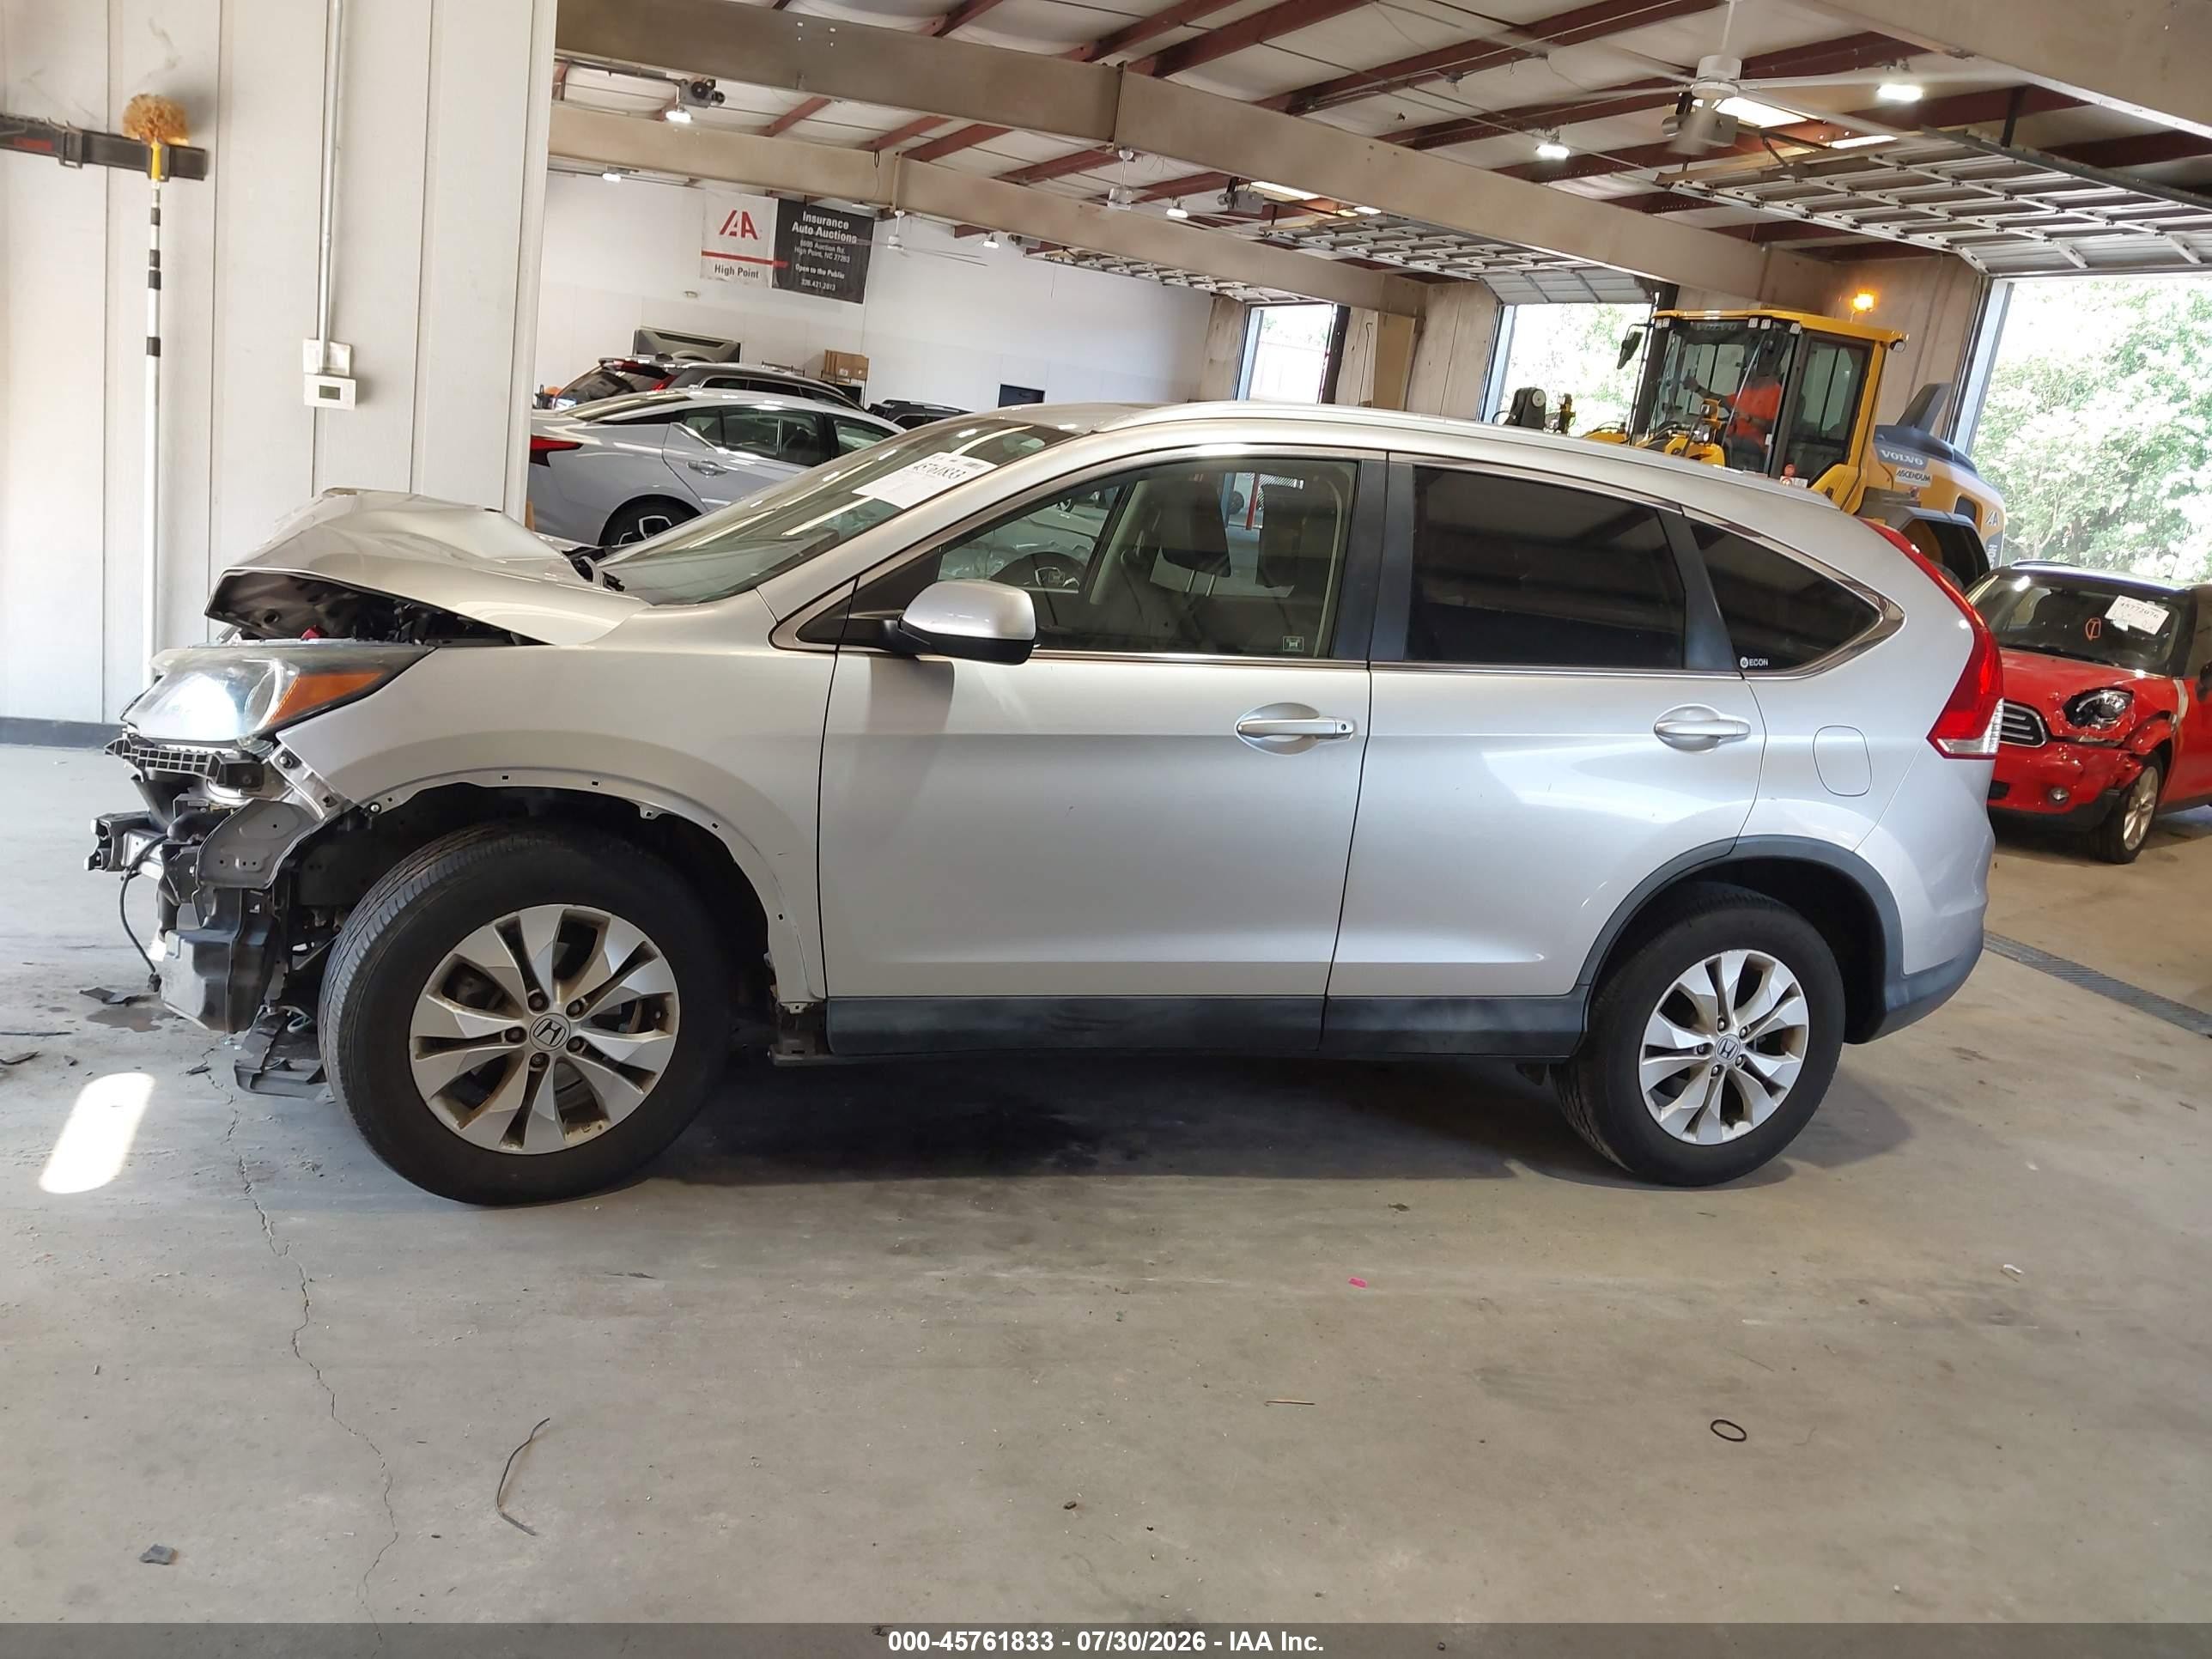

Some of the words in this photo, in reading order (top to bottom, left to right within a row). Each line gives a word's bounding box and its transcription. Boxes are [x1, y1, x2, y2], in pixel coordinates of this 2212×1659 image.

[802, 210, 849, 229] Insurance
[792, 221, 813, 235] Auto
[815, 226, 858, 244] Auctions
[794, 246, 807, 255] High
[824, 252, 833, 260] NC
[814, 241, 836, 252] Auction
[714, 263, 735, 276] High
[737, 267, 759, 279] Point
[795, 263, 810, 273] Open
[817, 267, 827, 276] the
[827, 270, 845, 280] Public
[1881, 449, 1924, 465] VOLVO
[1896, 469, 1931, 482] ASCENDUM
[1748, 658, 1769, 667] ECON
